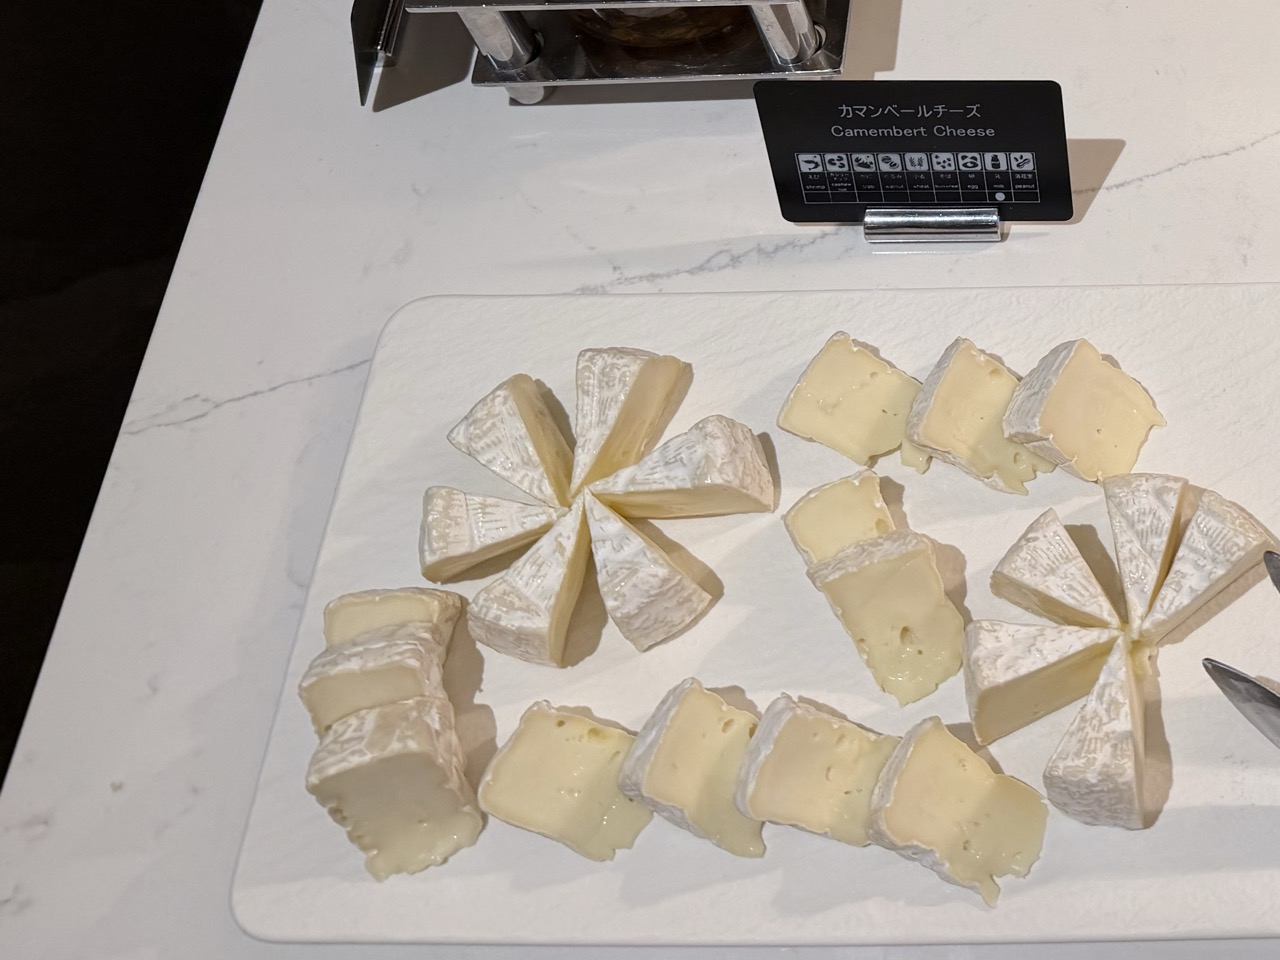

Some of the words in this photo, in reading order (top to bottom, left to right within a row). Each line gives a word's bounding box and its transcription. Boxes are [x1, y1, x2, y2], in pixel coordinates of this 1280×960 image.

[838, 103, 981, 119] カマンベールチーズ
[830, 125, 928, 137] Camembert
[933, 124, 995, 137] Cheese
